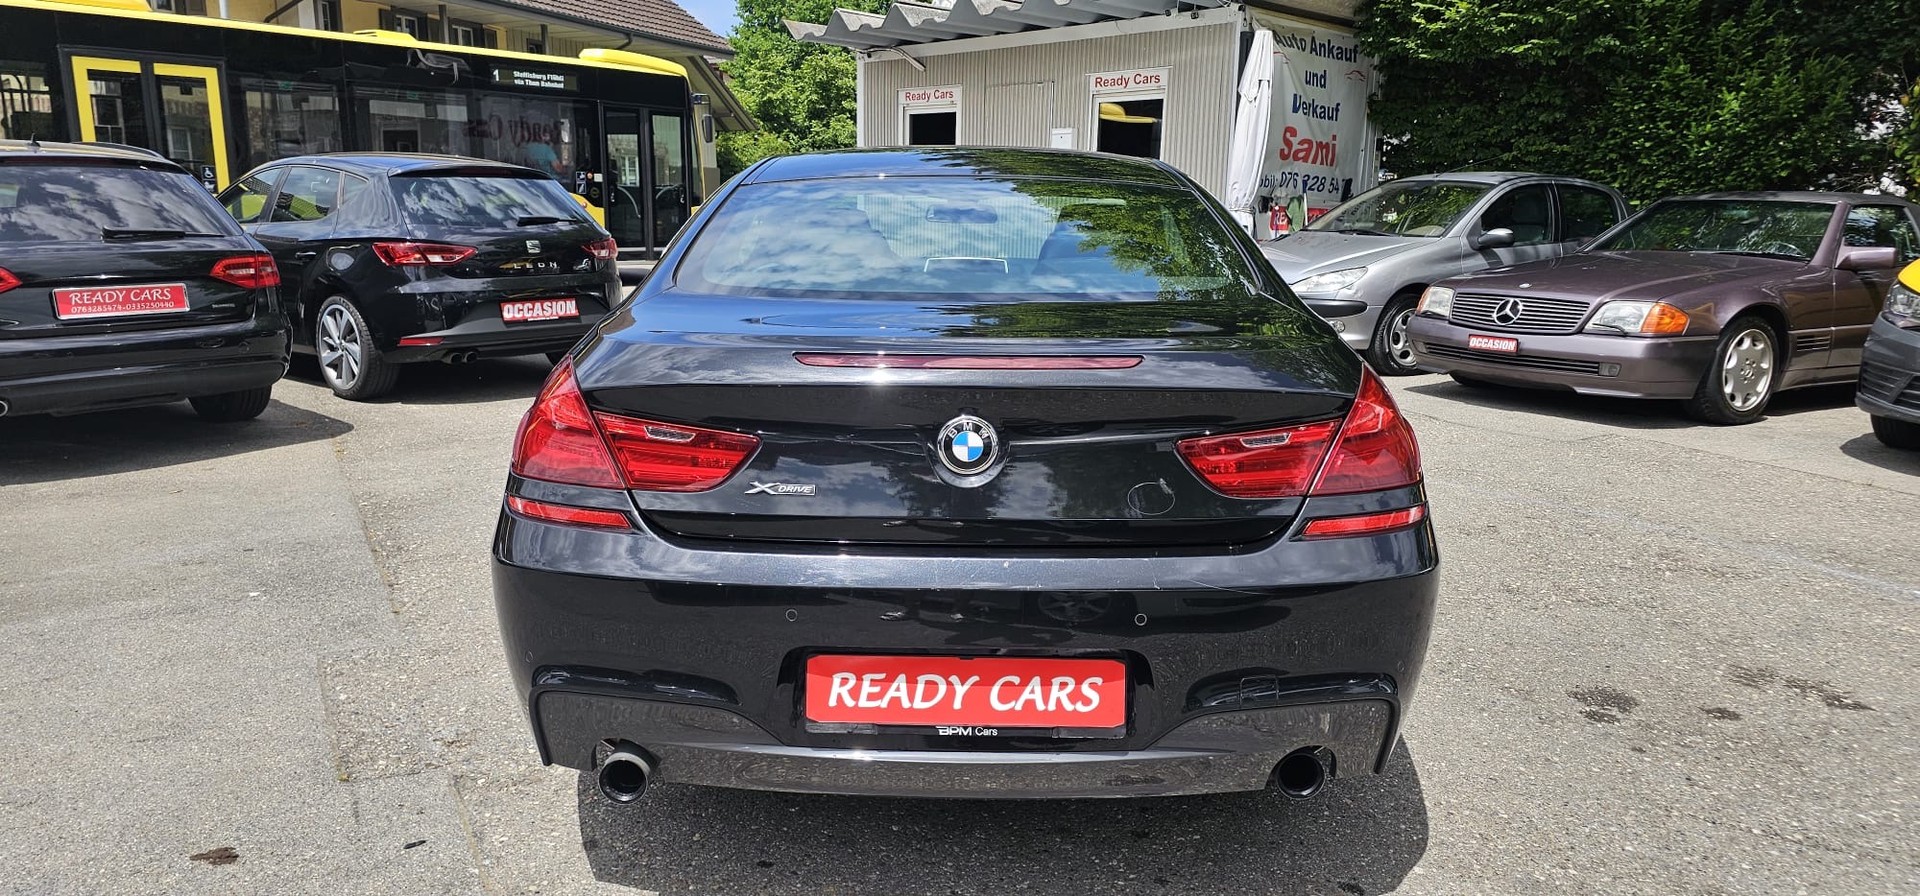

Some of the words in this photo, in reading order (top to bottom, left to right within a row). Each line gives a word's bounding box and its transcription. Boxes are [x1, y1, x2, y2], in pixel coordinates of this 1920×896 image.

[1272, 29, 1307, 52] Auto
[1310, 36, 1359, 63] Ankauf
[493, 69, 499, 81] 1
[1095, 75, 1130, 88] Ready
[1133, 73, 1161, 85] Cars
[1305, 70, 1327, 89] und
[905, 90, 931, 102] Ready
[933, 89, 954, 99] Cars
[1292, 93, 1341, 121] Verkauf
[1280, 126, 1337, 167] Sami
[1279, 171, 1299, 189] 076
[69, 290, 126, 305] READY
[130, 288, 172, 301] CARS
[503, 300, 576, 318] OCCASION
[1470, 337, 1515, 350] OCCASION
[948, 422, 990, 438] BMW
[828, 672, 980, 710] READY
[989, 675, 1103, 713] CARS
[935, 726, 972, 736] BPM
[975, 726, 998, 736] Cars
